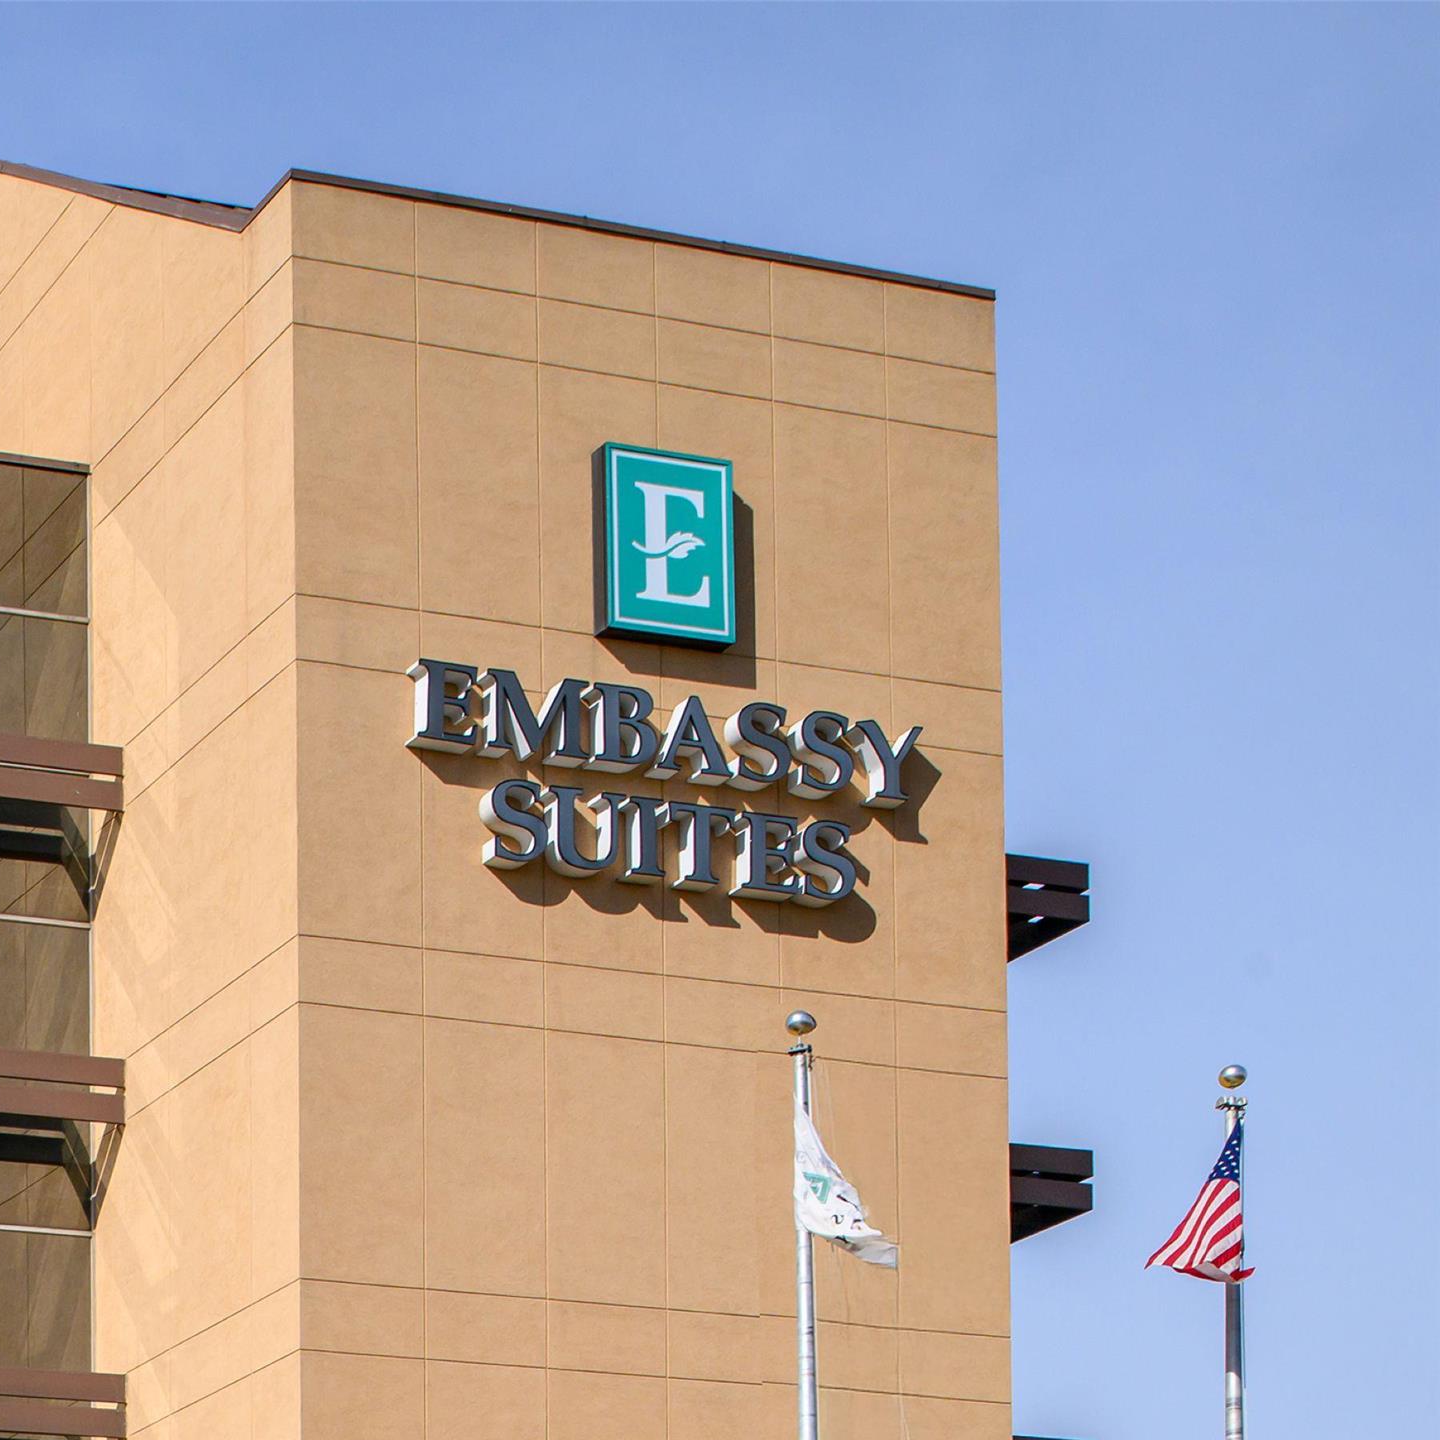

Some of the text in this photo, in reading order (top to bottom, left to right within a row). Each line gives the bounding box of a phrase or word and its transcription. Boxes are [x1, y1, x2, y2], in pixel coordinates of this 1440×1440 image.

[632, 481, 711, 608] E
[405, 658, 924, 811] EMBASSY
[479, 778, 858, 909] SUITES
